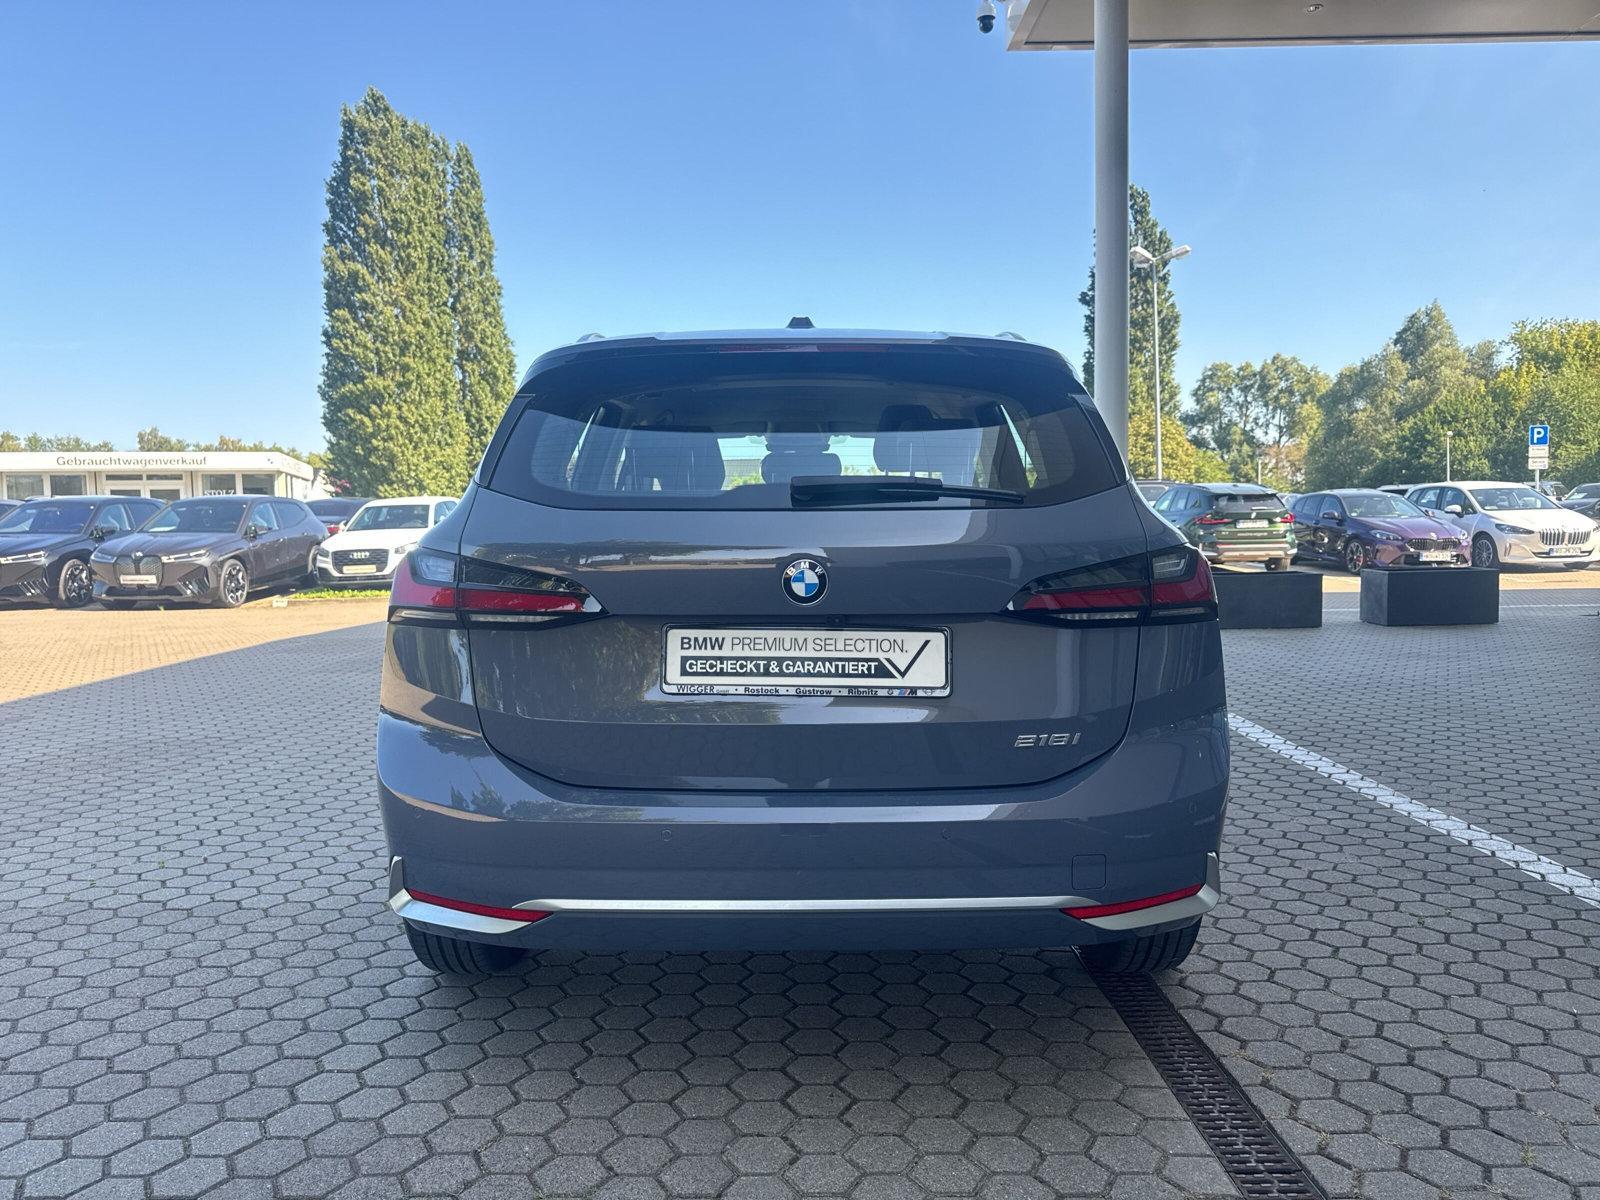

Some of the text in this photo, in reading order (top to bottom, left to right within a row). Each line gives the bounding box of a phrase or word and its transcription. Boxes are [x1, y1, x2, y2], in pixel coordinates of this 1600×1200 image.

[1533, 428, 1545, 444] P
[56, 456, 207, 468] Gebrauchtwagenverkauf
[786, 561, 825, 576] BMW
[680, 636, 908, 653] BMW PREMIUM SELECTION.
[686, 660, 878, 674] GECHECKT & GARANTIERT
[676, 685, 715, 694] WIGGER
[744, 686, 780, 694] Rostock
[847, 688, 879, 696] Ribnitz
